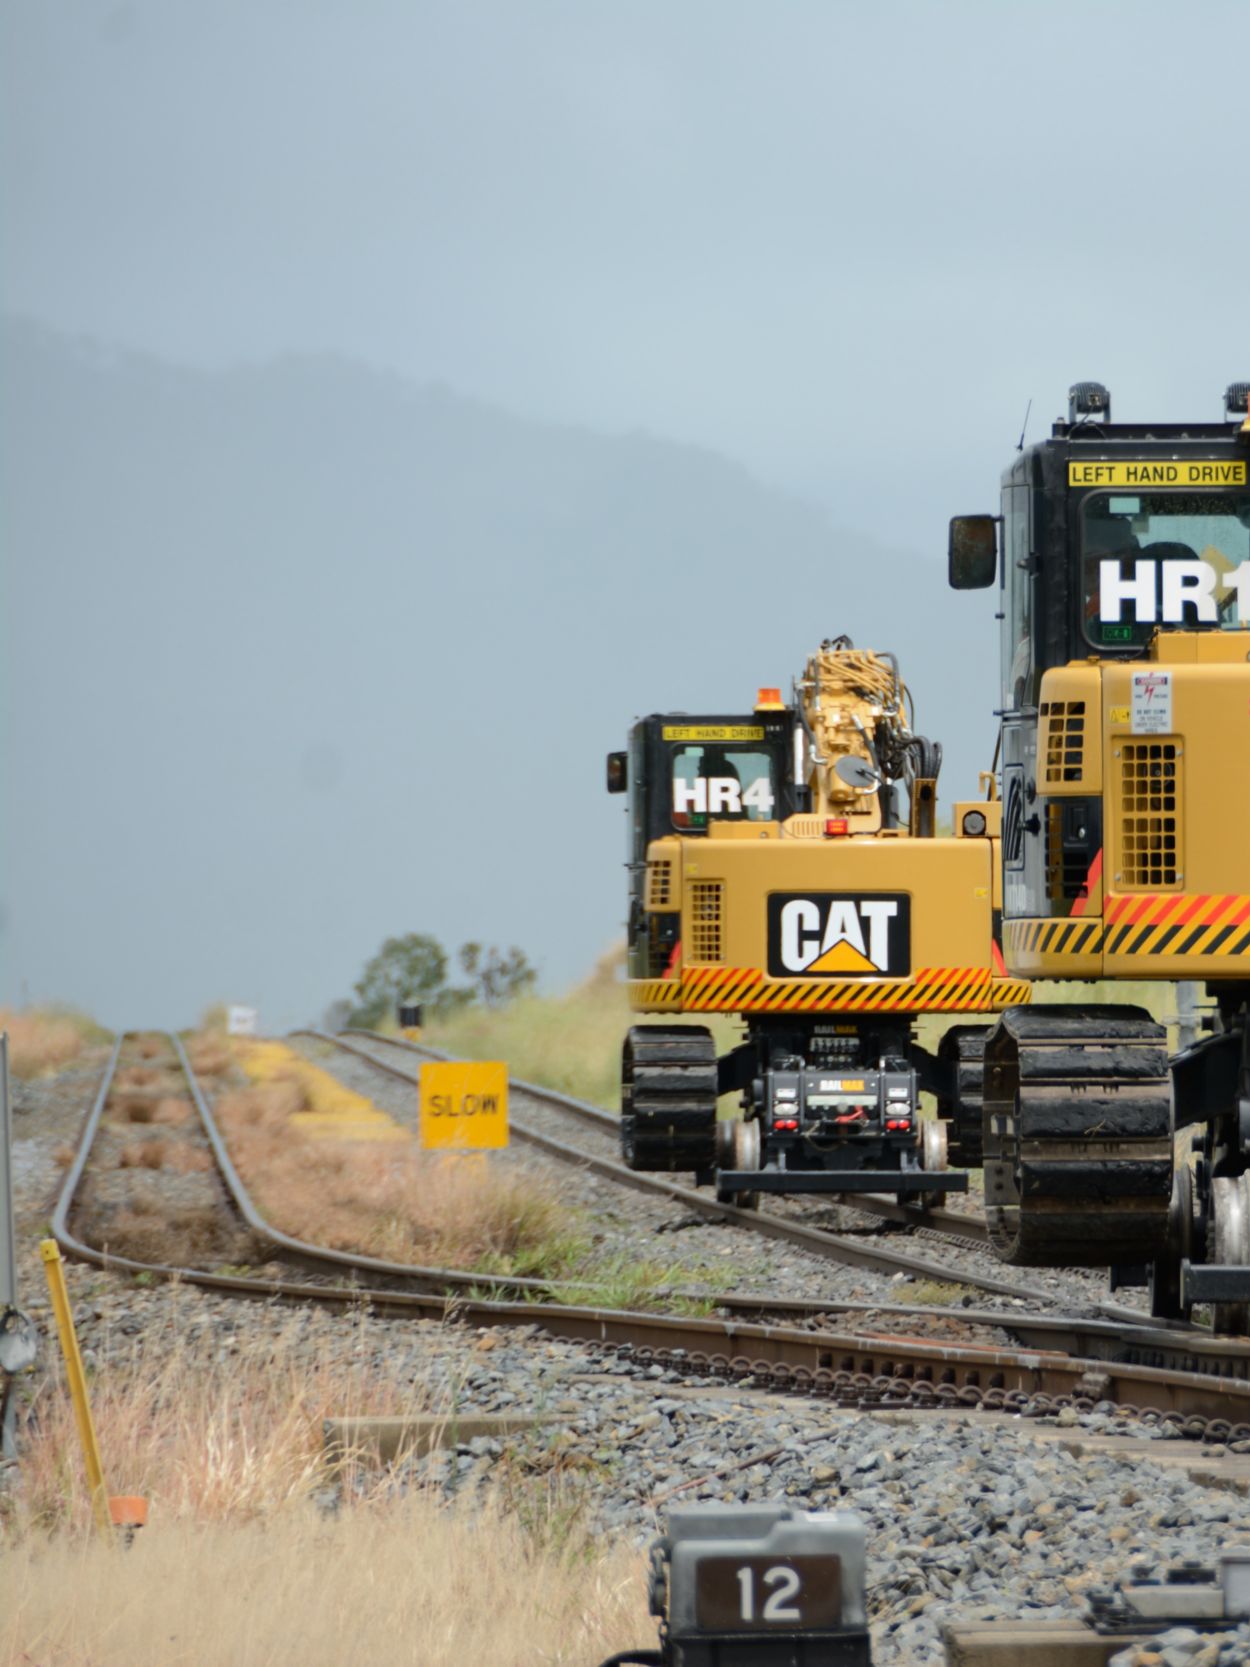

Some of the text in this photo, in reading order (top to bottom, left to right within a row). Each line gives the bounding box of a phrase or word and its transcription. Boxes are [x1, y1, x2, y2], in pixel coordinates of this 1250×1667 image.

[1072, 465, 1244, 483] LEFT HAND DRIVE
[666, 728, 690, 738] LEFT
[696, 728, 726, 738] HAND
[731, 728, 763, 738] DRIVE
[674, 777, 775, 813] HR4
[781, 899, 898, 972] CAT
[429, 1094, 499, 1117] SLOW
[736, 1566, 801, 1621] 12
